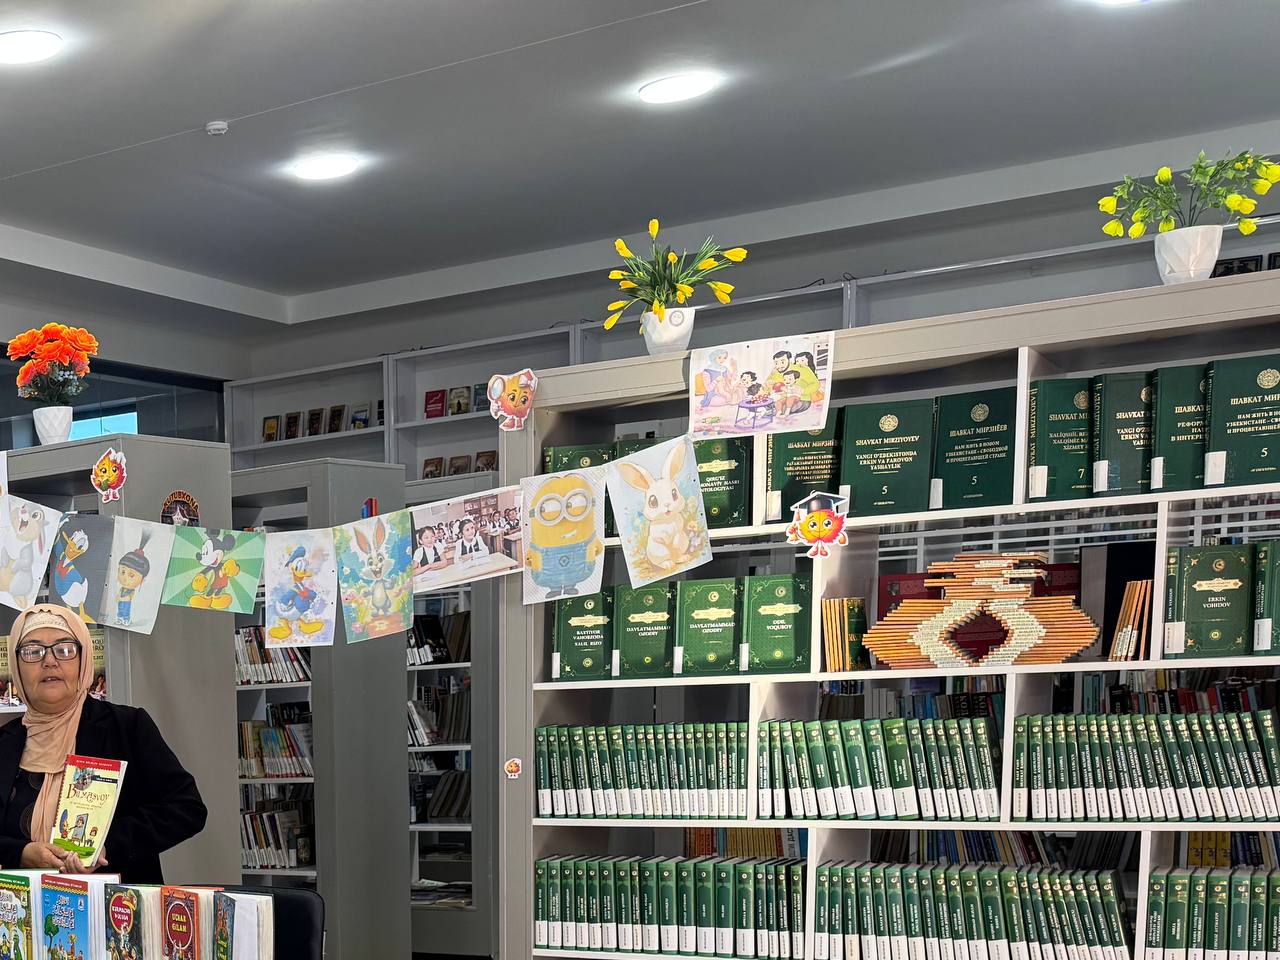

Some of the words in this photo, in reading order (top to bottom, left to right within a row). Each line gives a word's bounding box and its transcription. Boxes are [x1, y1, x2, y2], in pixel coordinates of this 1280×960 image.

[1231, 396, 1262, 405] ШАВКАТ
[1049, 413, 1077, 421] SHAVKAT
[1116, 411, 1145, 419] SHAVKAT
[950, 428, 975, 437] ШАВКАТ
[976, 424, 1008, 434] МИРЗИЁЕВ
[856, 438, 883, 446] SHAVKAT
[884, 435, 920, 444] MIRZIYOYEV
[1261, 448, 1268, 457] 5
[1078, 468, 1085, 478] 7
[971, 475, 978, 485] 5
[882, 485, 888, 494] 5
